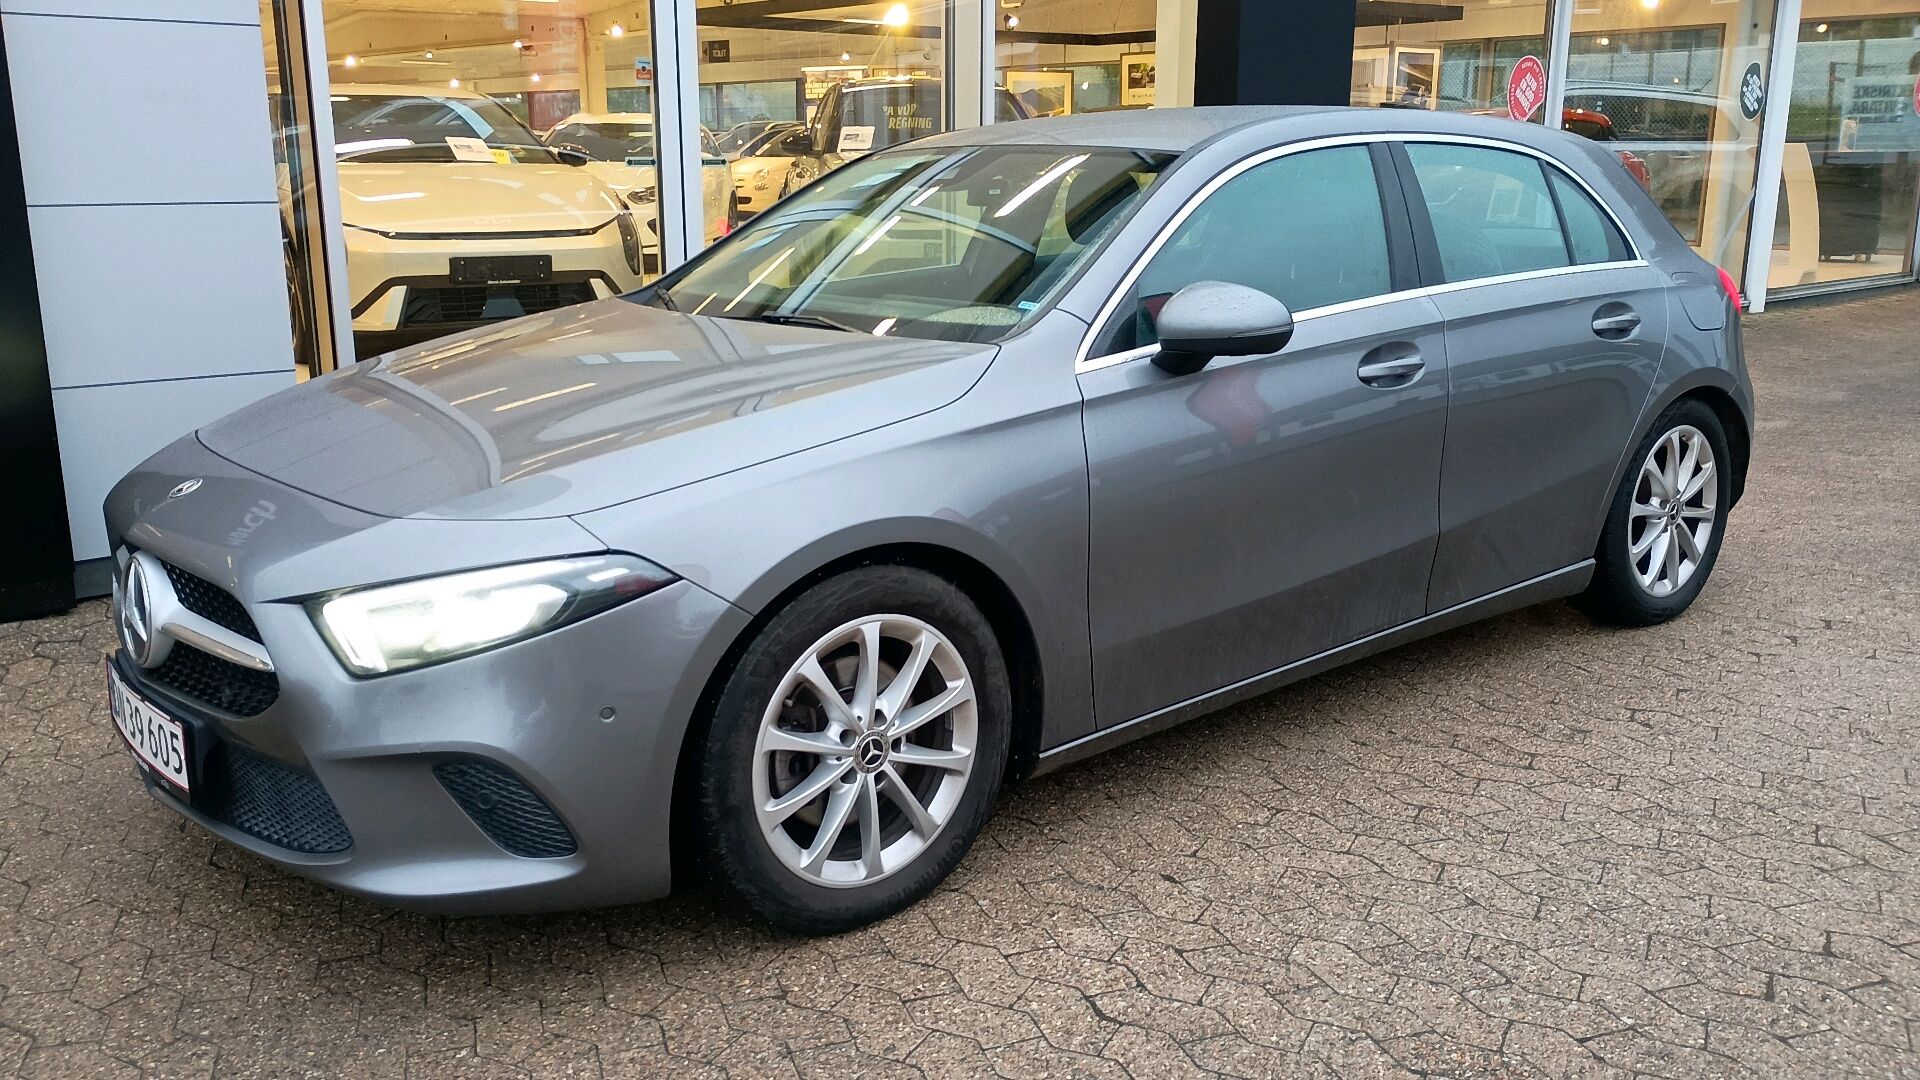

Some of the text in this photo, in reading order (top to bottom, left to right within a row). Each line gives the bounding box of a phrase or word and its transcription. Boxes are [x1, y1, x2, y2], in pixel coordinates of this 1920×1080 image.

[888, 117, 933, 129] REGNING
[125, 696, 144, 750] 39
[148, 715, 183, 775] 605
